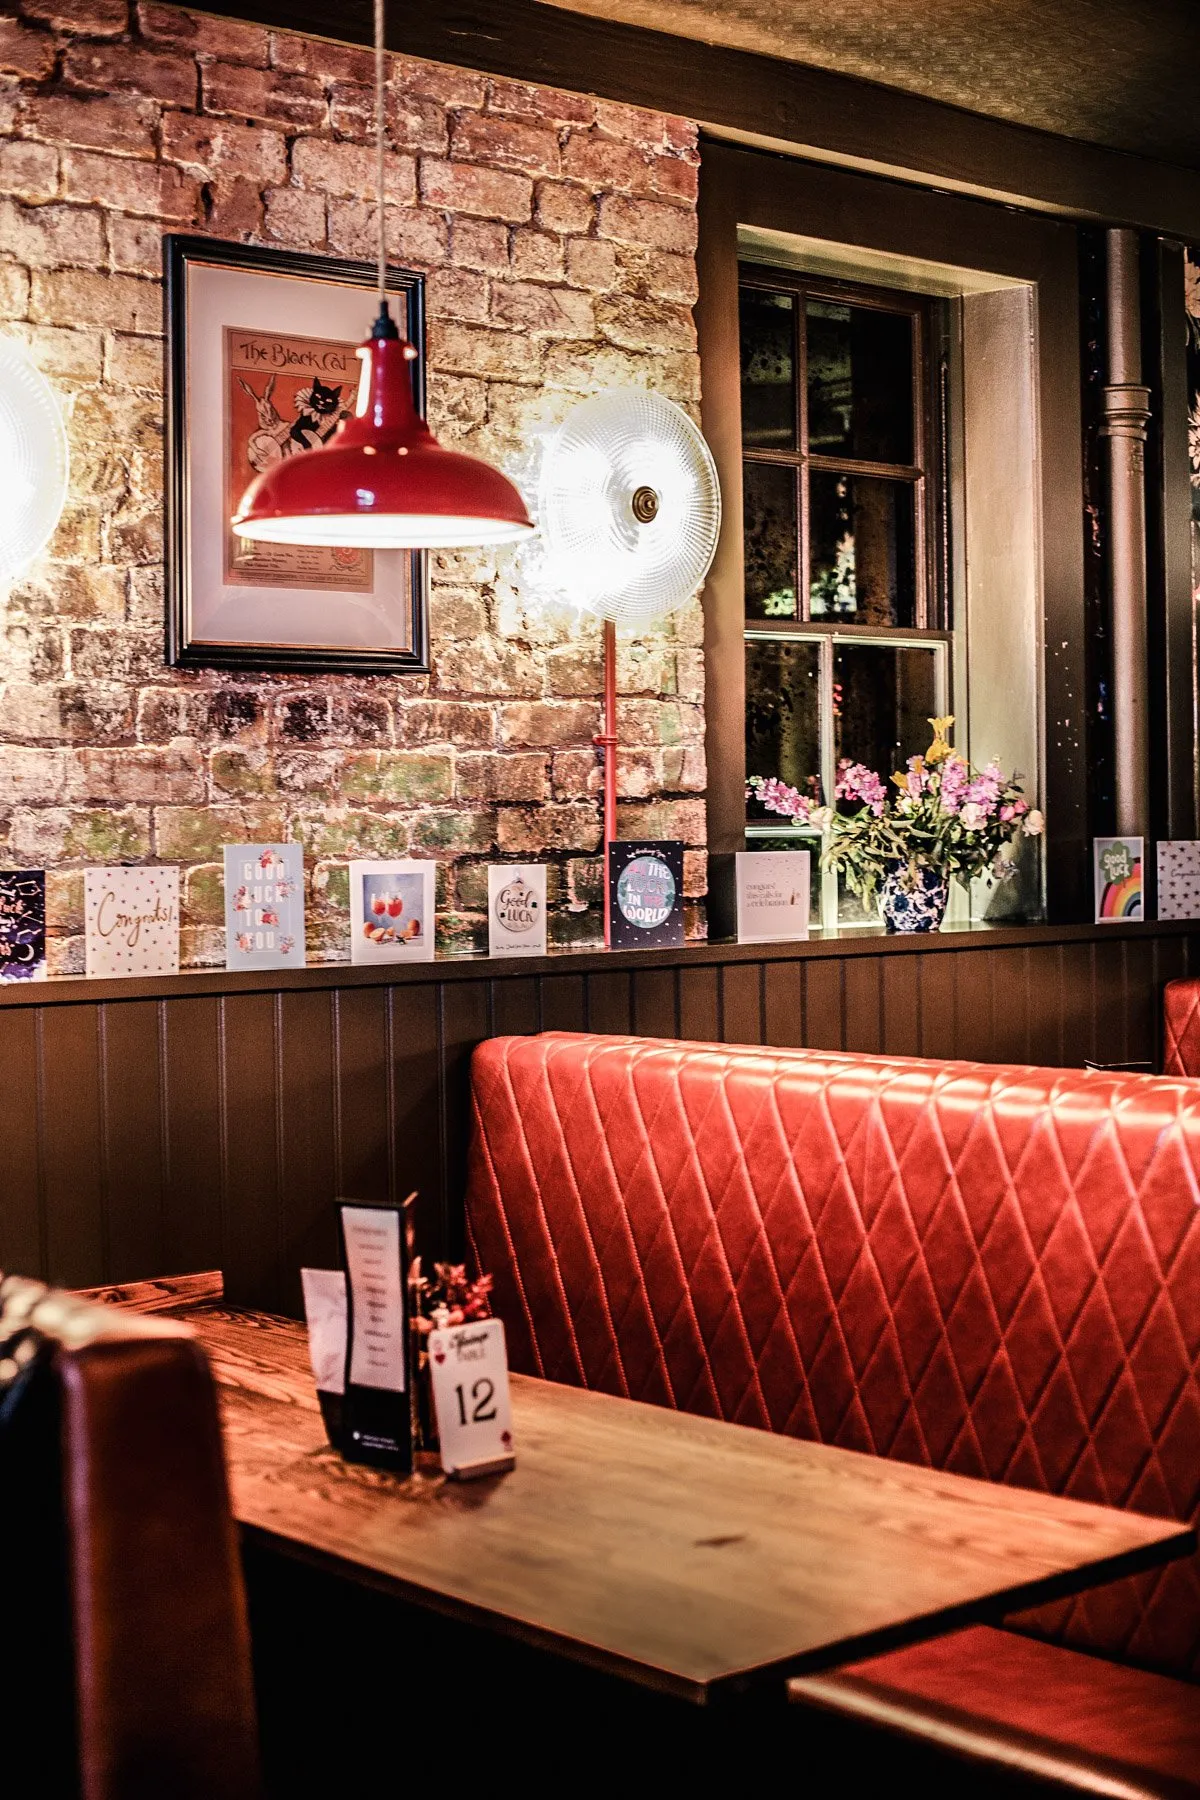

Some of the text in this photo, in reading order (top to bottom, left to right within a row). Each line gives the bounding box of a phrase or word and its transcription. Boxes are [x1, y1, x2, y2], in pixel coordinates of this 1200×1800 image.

[240, 340, 359, 372] The Black Cat
[1103, 849, 1127, 868] good
[245, 862, 285, 880] GOOD
[648, 862, 671, 880] THE
[500, 889, 533, 911] Good
[627, 893, 641, 906] IN
[507, 909, 534, 923] LUCK
[623, 904, 669, 923] WORLD
[455, 1377, 498, 1426] 12
